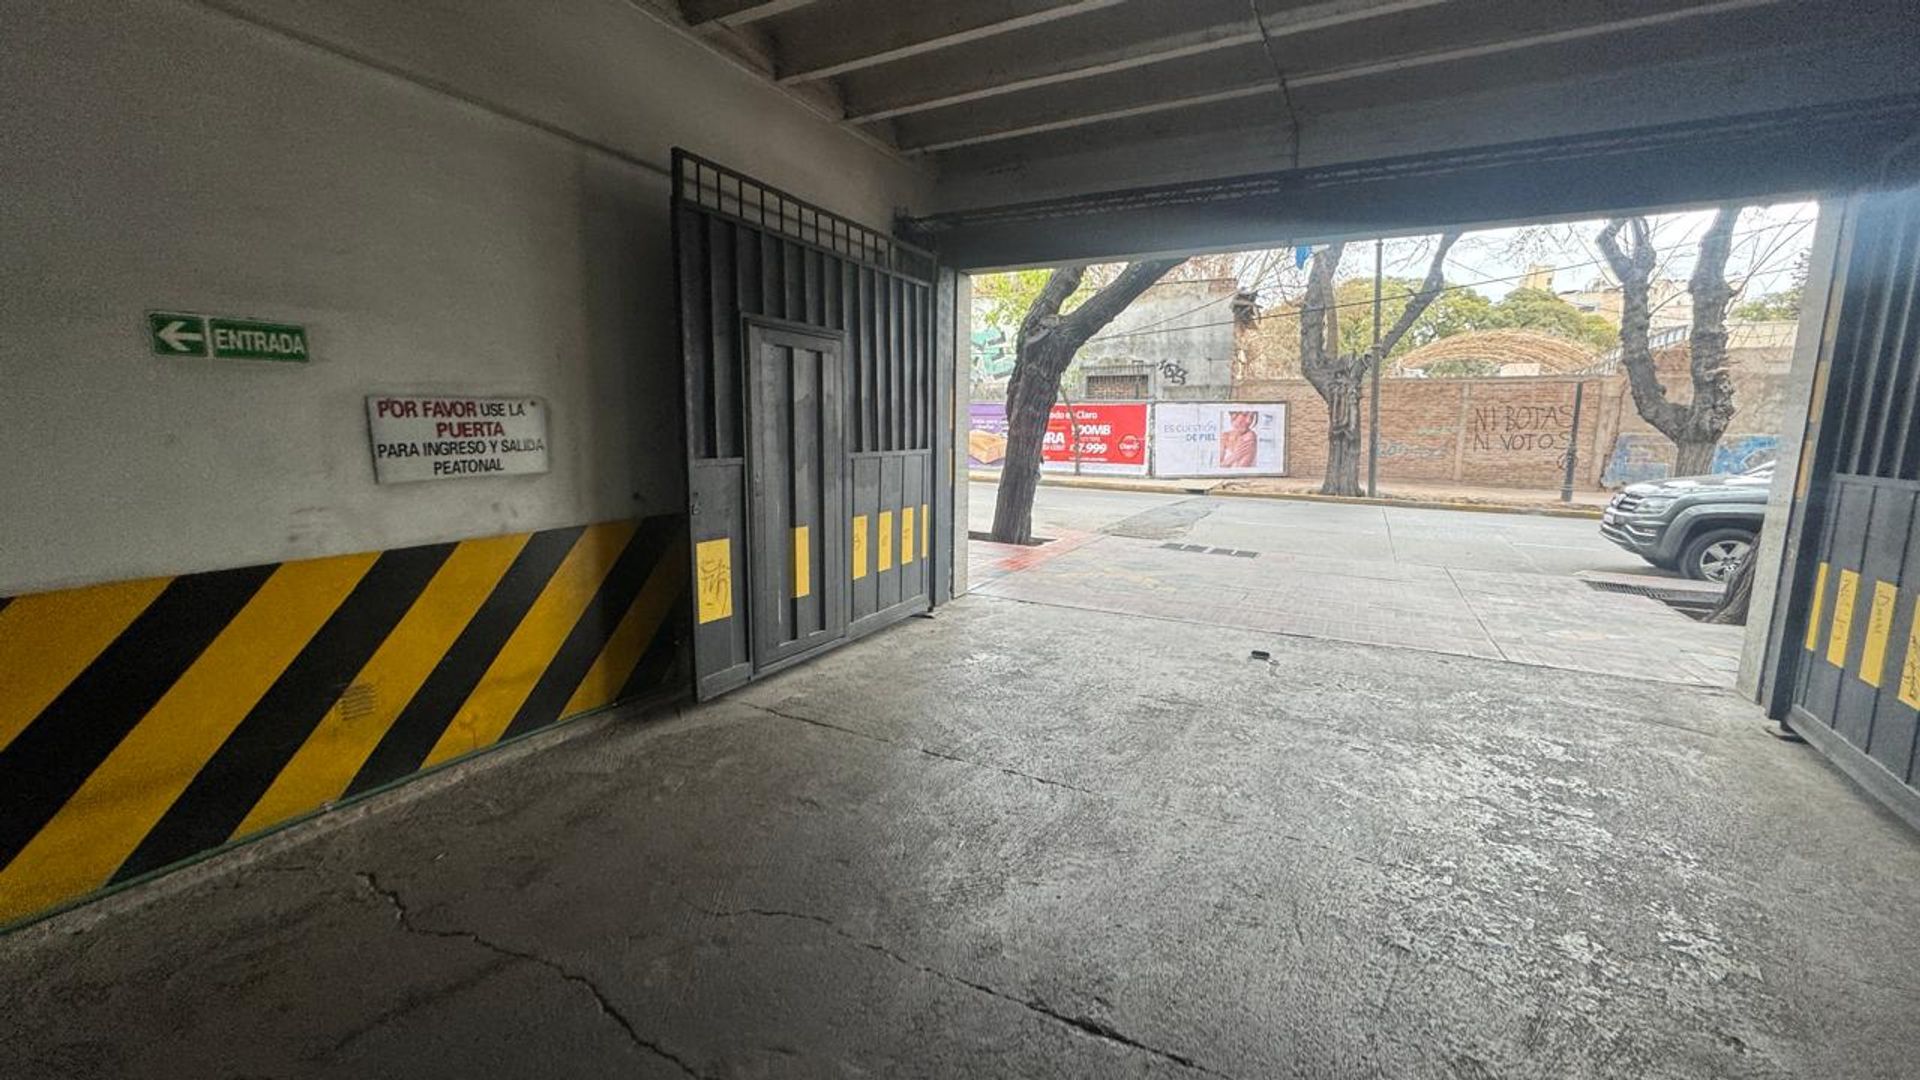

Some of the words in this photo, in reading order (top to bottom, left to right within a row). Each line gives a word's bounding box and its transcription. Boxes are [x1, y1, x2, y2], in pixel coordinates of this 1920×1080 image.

[215, 329, 306, 354] ENTRADA
[378, 400, 418, 418] POR
[422, 400, 477, 418] FAVOR
[480, 403, 505, 417] USE
[509, 403, 525, 417] LA
[1076, 411, 1098, 419] Claro
[1474, 407, 1496, 431] NI
[436, 421, 505, 438] PUERTA
[1164, 424, 1175, 433] ES
[1186, 433, 1198, 442] DE
[1199, 433, 1217, 442] PIEL
[378, 443, 420, 459] PARA
[423, 440, 486, 457] INGRESO
[488, 440, 498, 454] Y
[501, 438, 543, 453] SALIDA
[433, 459, 504, 476] PEATONAL
